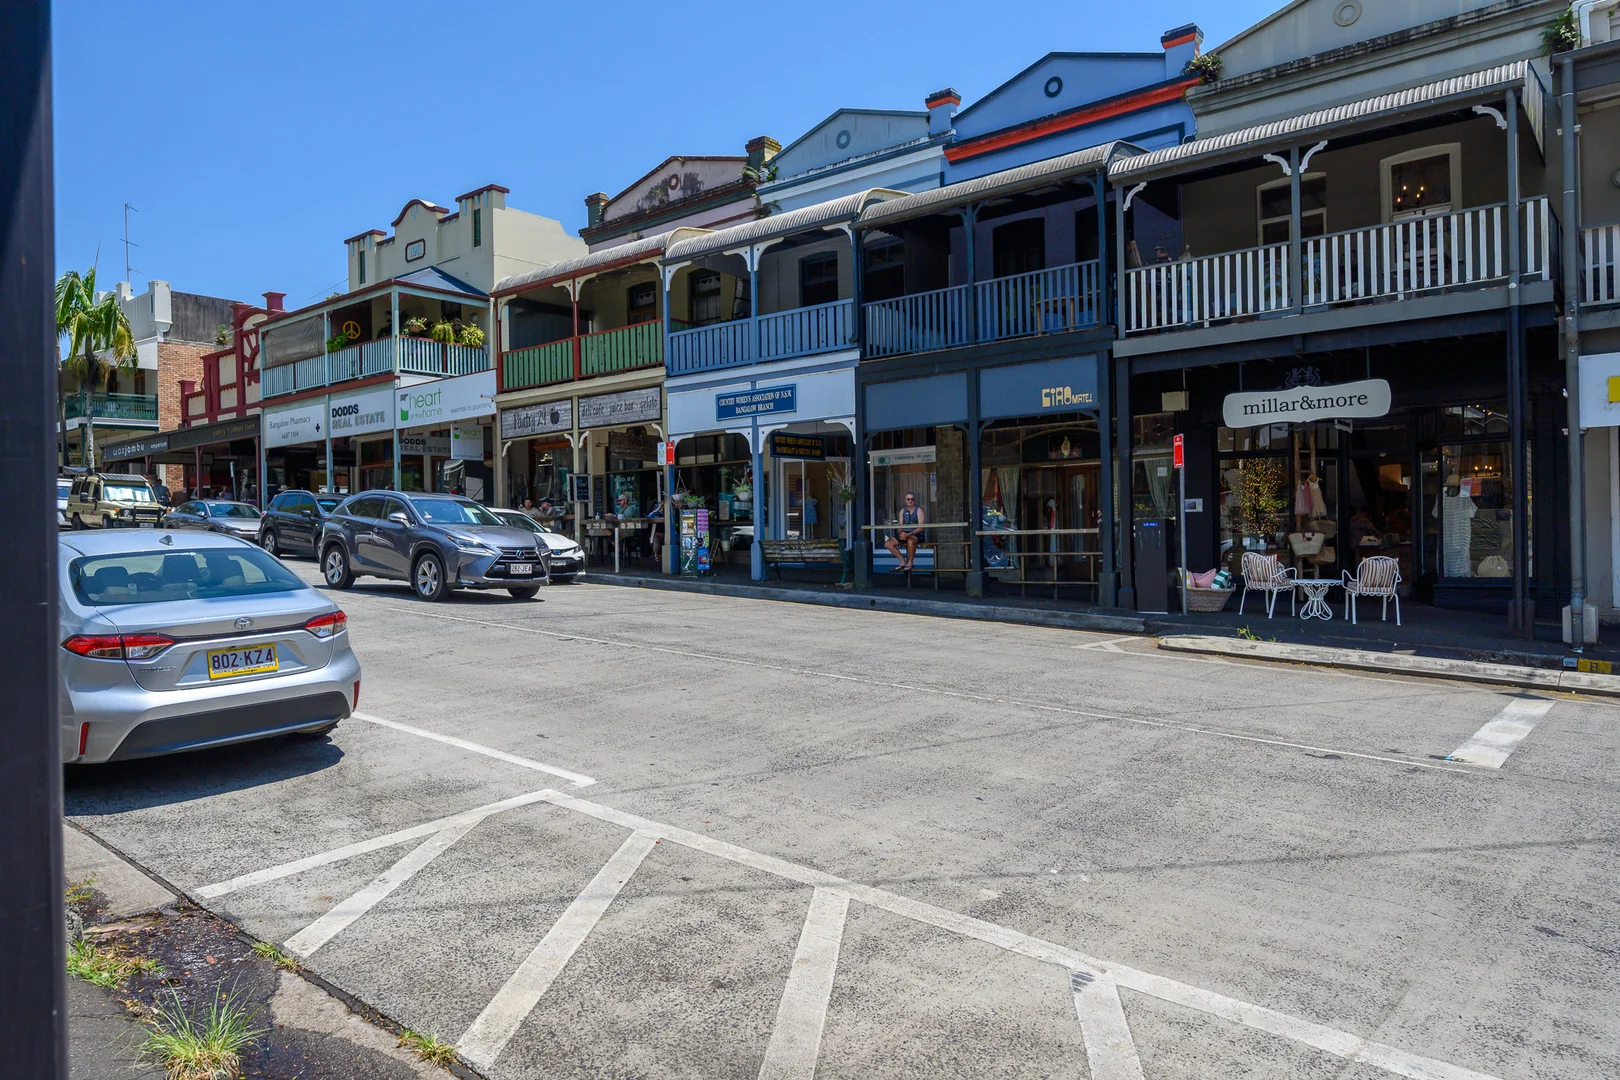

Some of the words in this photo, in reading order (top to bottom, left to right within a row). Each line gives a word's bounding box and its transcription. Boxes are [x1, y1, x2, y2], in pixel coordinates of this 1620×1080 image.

[409, 388, 442, 410] heart
[581, 404, 591, 417] deli
[593, 402, 604, 416] cafe
[609, 402, 623, 416] juice
[624, 400, 634, 411] bar
[640, 396, 657, 414] gelato
[719, 397, 735, 406] COUNTRY
[752, 391, 774, 402] ASSOCIATION
[775, 391, 780, 399] OF
[1243, 393, 1368, 415] millar&more
[332, 404, 359, 418] DODDS
[422, 407, 442, 417] home
[735, 404, 757, 414] BANGALOW
[757, 402, 774, 411] BRANCH
[270, 419, 289, 430] Bangalow
[290, 416, 310, 426] Pharmacy
[332, 417, 352, 430] REAL
[354, 411, 385, 426] ESTATE
[513, 411, 536, 432] Pantry
[537, 408, 547, 427] 24
